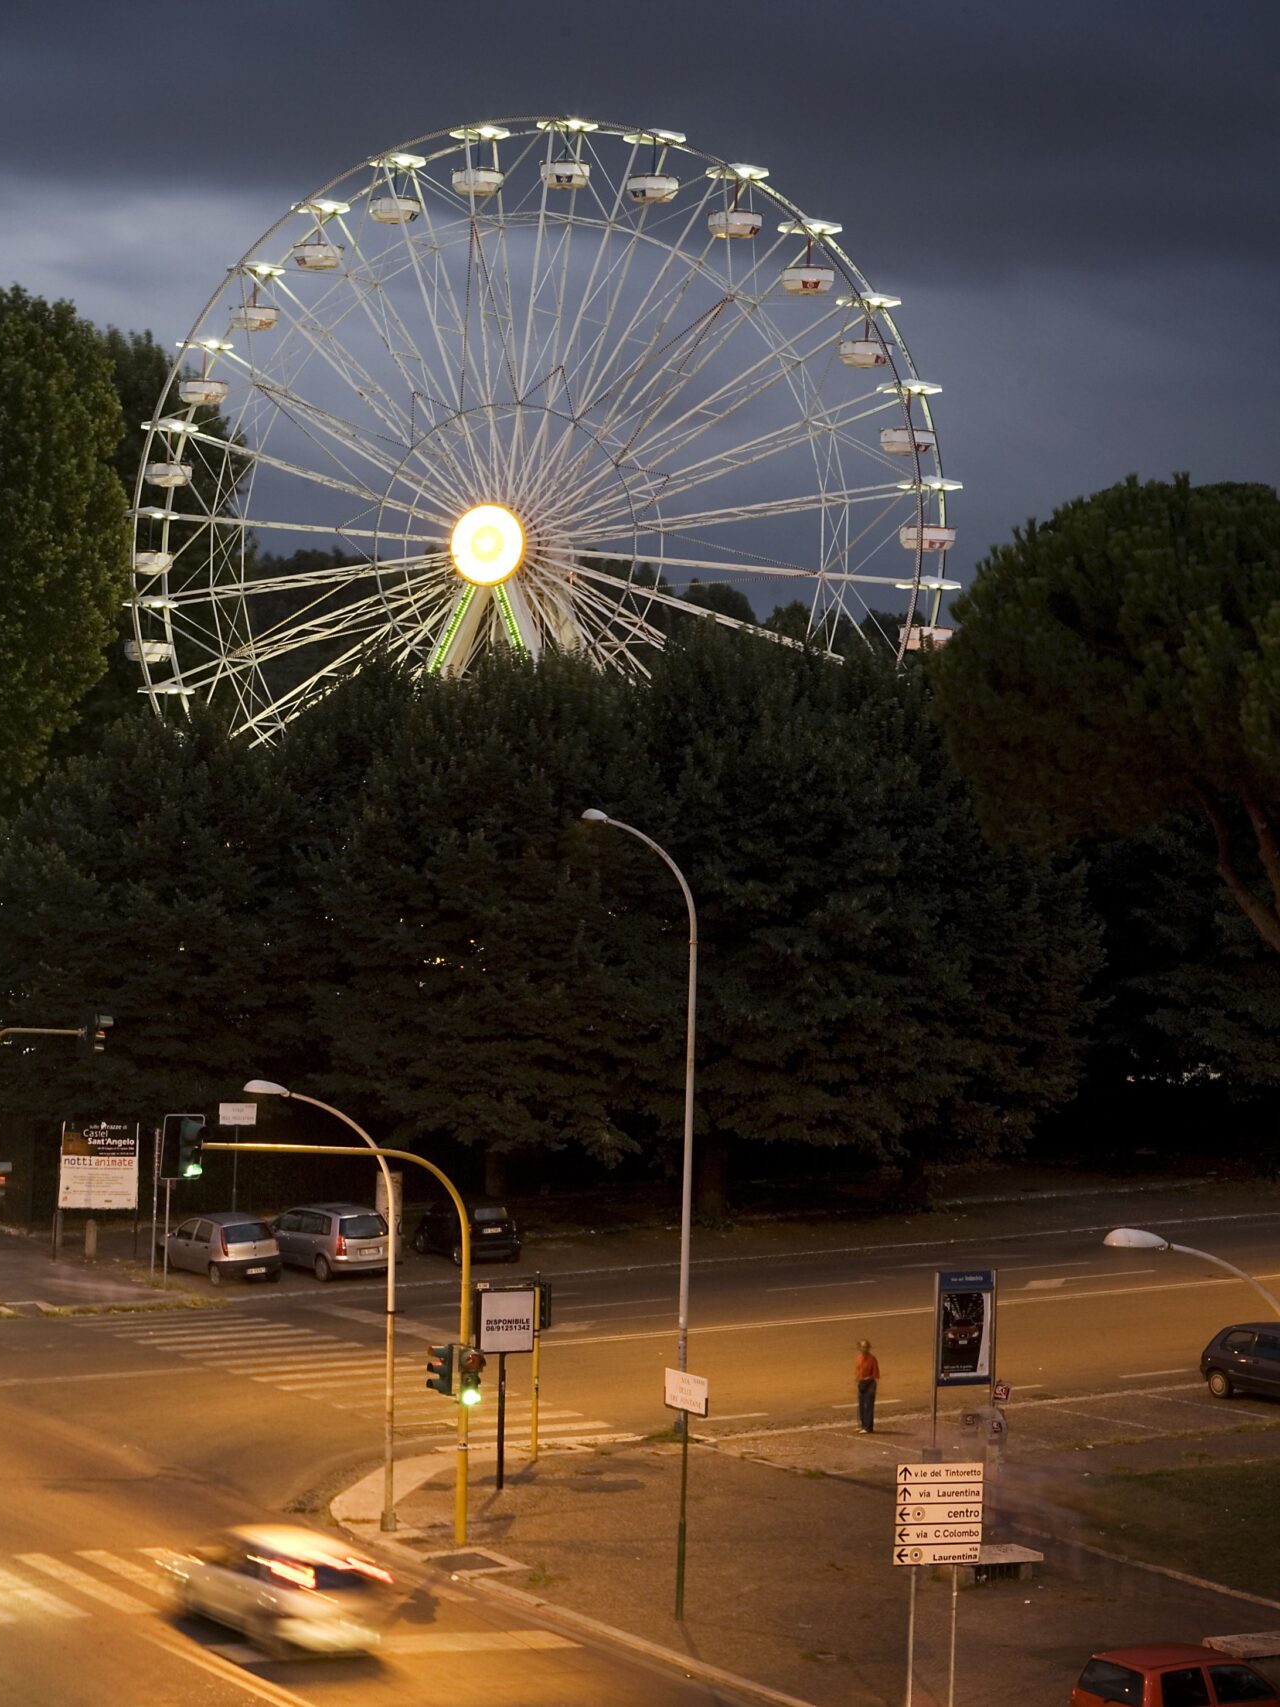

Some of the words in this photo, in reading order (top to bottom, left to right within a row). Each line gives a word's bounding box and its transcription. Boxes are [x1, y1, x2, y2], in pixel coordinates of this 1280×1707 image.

[83, 1129, 108, 1138] Castel
[88, 1137, 135, 1147] Sant'Angelo
[64, 1156, 92, 1166] notti
[95, 1156, 133, 1167] animate
[930, 1469, 941, 1477] del
[944, 1469, 981, 1477] Tintoretto
[919, 1489, 931, 1498] via
[937, 1488, 980, 1498] Laurentina
[947, 1508, 980, 1518] centro
[916, 1530, 928, 1539] via
[933, 1552, 978, 1562] Laurentina
